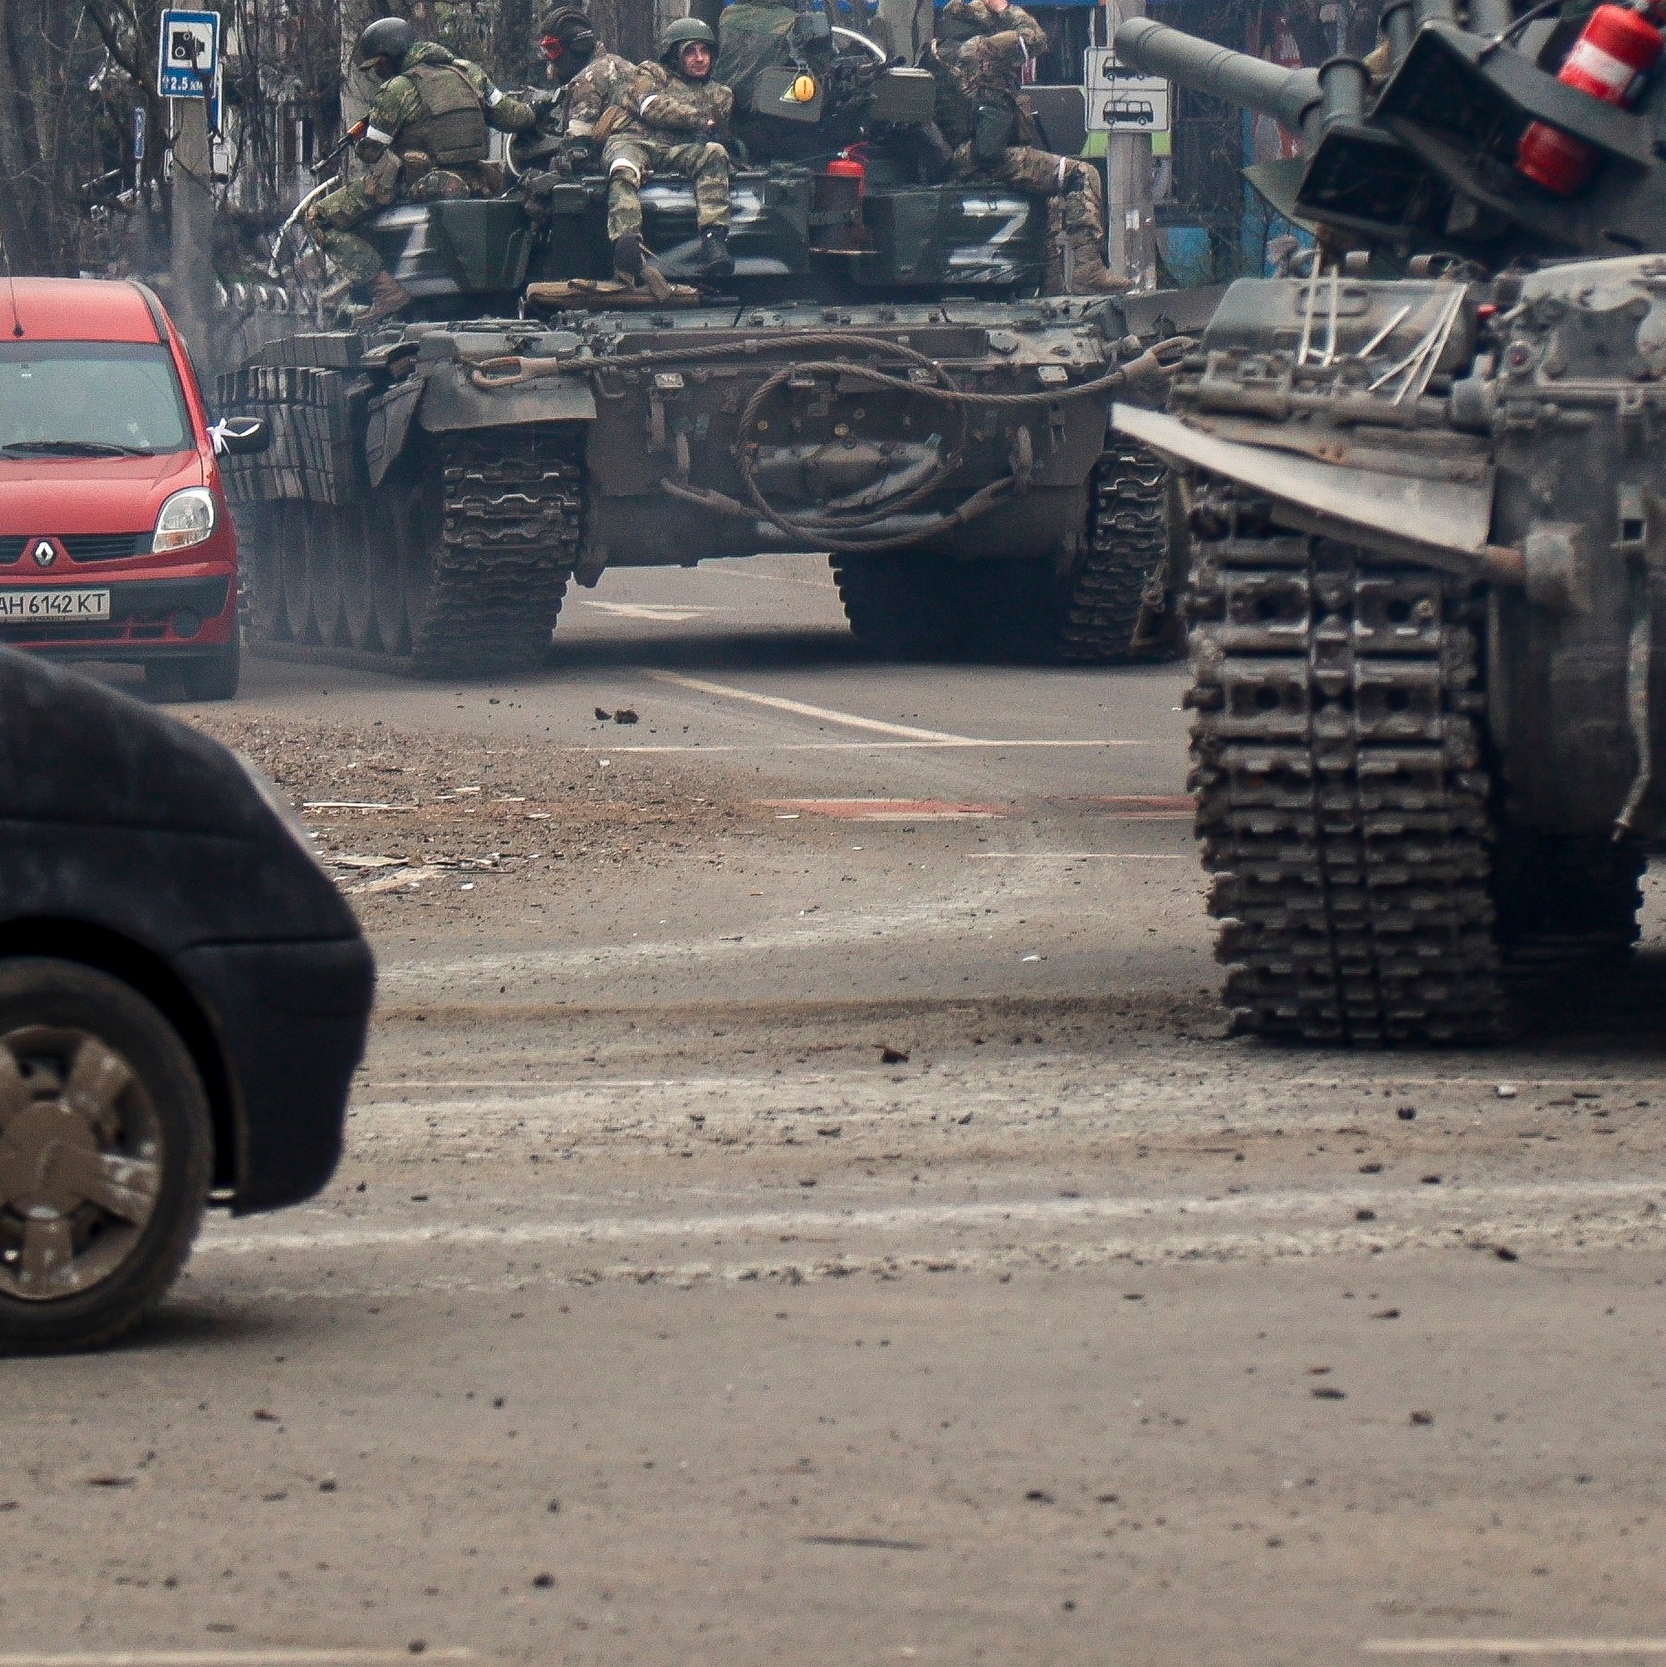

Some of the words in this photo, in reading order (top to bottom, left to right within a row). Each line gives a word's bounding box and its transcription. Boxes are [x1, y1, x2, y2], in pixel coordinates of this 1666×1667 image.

[171, 77, 188, 90] 2.5
[947, 199, 1030, 275] Z
[28, 594, 73, 614] 6142
[77, 593, 106, 613] KT
